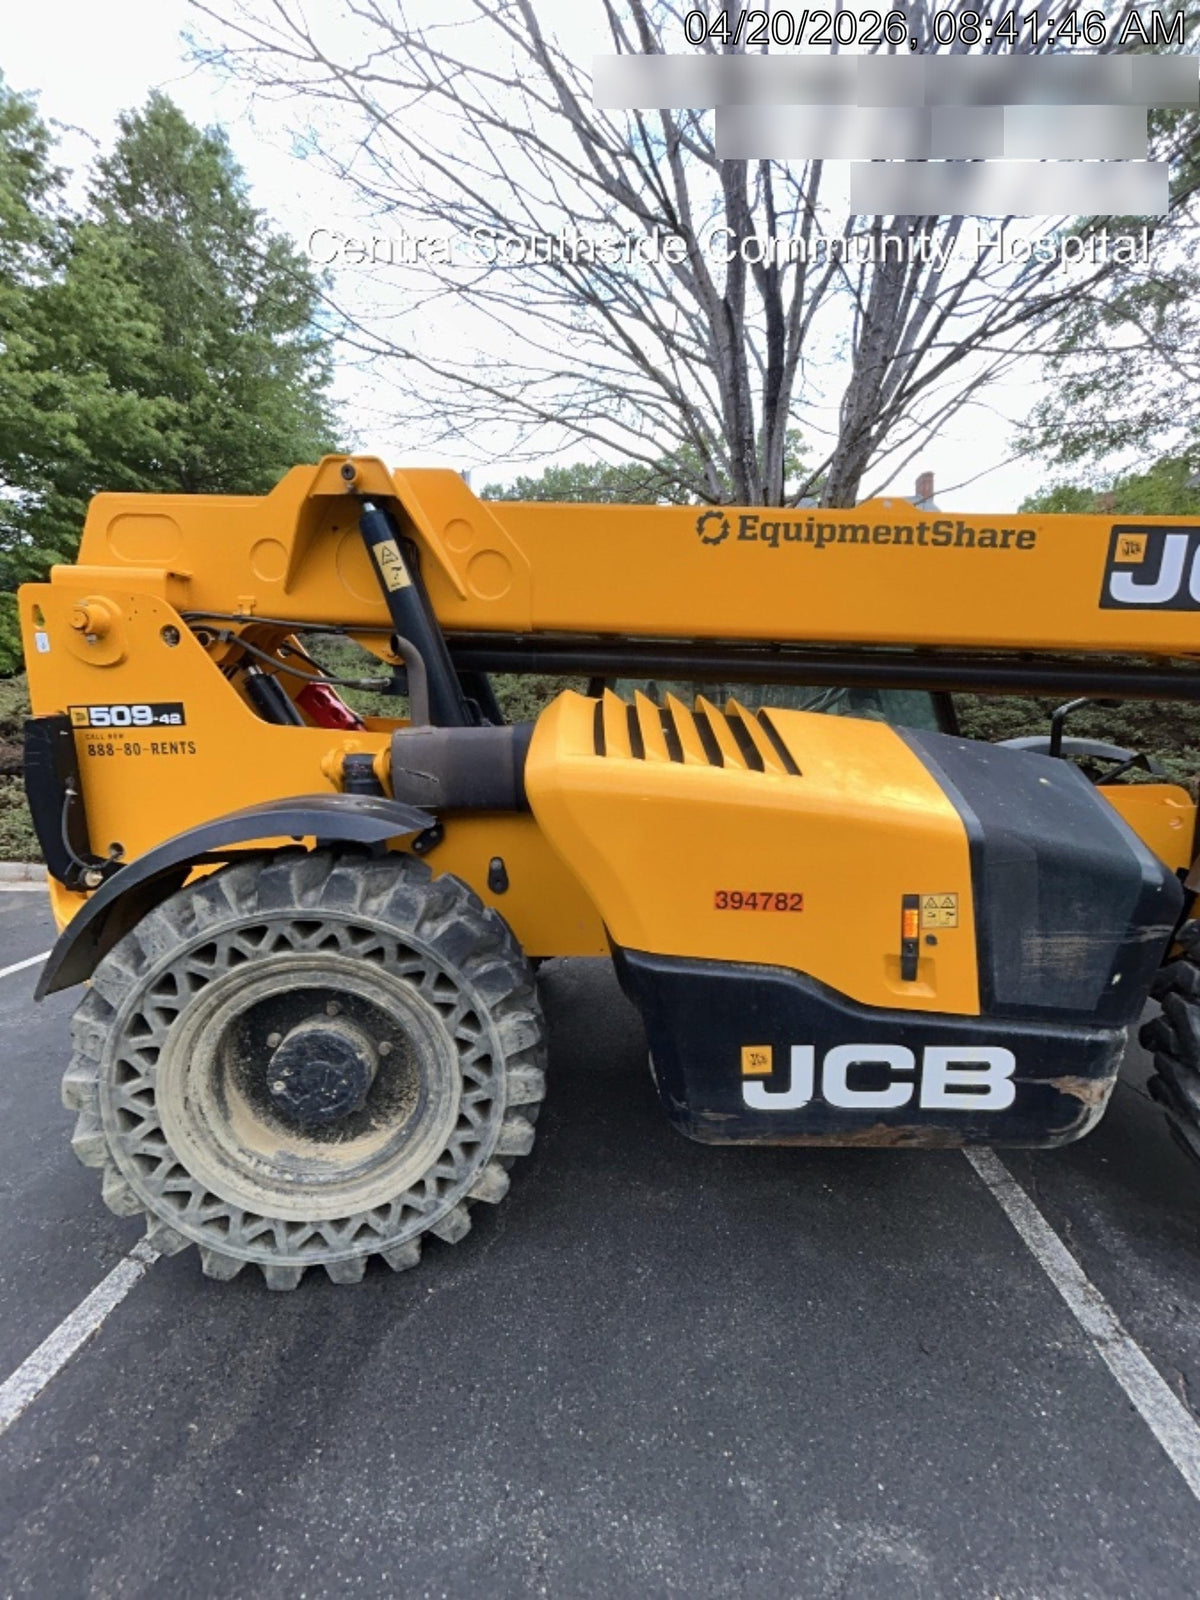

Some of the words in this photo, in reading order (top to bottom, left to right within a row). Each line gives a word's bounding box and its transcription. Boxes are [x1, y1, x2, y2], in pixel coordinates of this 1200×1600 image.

[737, 514, 1036, 550] EquipmentShare
[88, 741, 196, 757] 888-80-RENTS
[715, 891, 803, 911] 394782
[741, 1044, 1017, 1111] JCB
